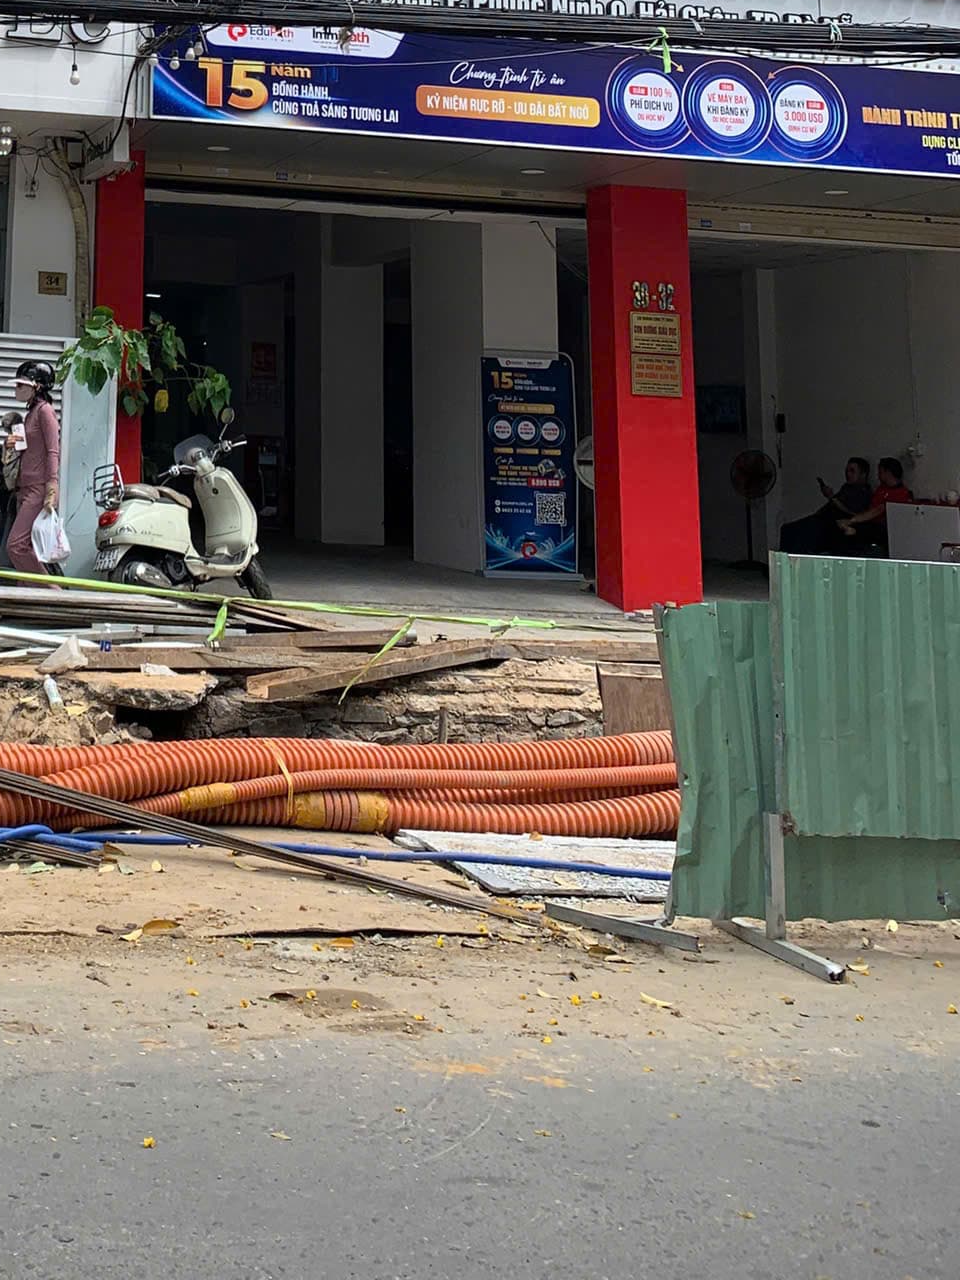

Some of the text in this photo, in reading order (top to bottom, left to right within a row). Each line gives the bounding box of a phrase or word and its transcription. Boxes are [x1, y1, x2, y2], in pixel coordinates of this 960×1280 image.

[198, 57, 269, 110] 15
[650, 87, 662, 98] 100
[322, 102, 347, 119] SÁNG
[383, 110, 399, 123] LAI
[443, 95, 467, 113] NIỆM
[904, 108, 947, 129] TRÌNH
[491, 371, 514, 389] 15
